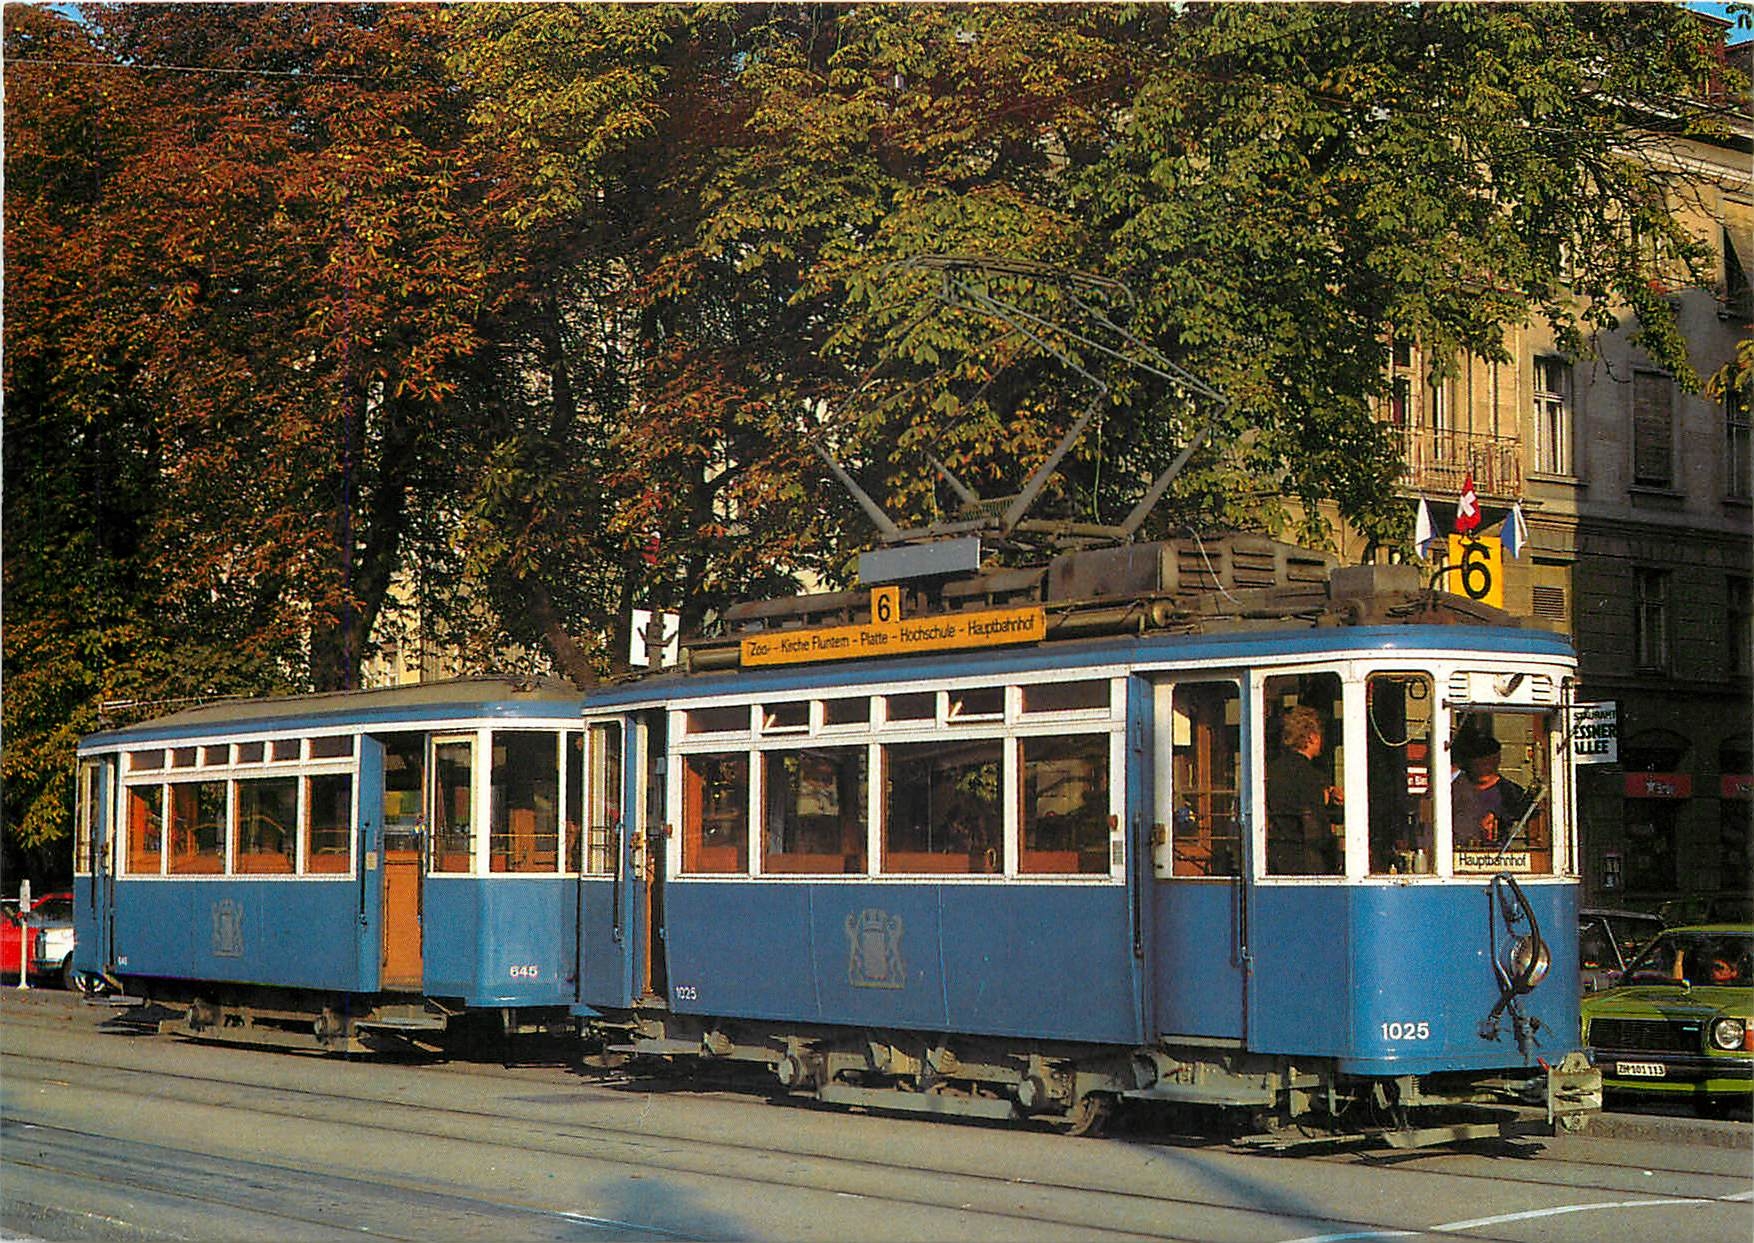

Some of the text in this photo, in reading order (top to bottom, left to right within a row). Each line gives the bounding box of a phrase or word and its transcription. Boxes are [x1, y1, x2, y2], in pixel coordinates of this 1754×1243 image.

[1461, 542, 1493, 600] 6
[877, 594, 891, 622] 6
[781, 638, 810, 653] Kirche
[860, 631, 889, 646] Platte
[900, 624, 955, 642] Hochschule
[968, 614, 1034, 638] Hauptbahnhof
[1458, 852, 1527, 869] Hauptbahnhof
[509, 965, 538, 979] 645
[675, 986, 698, 1000] 1025
[1380, 1022, 1430, 1041] 1025
